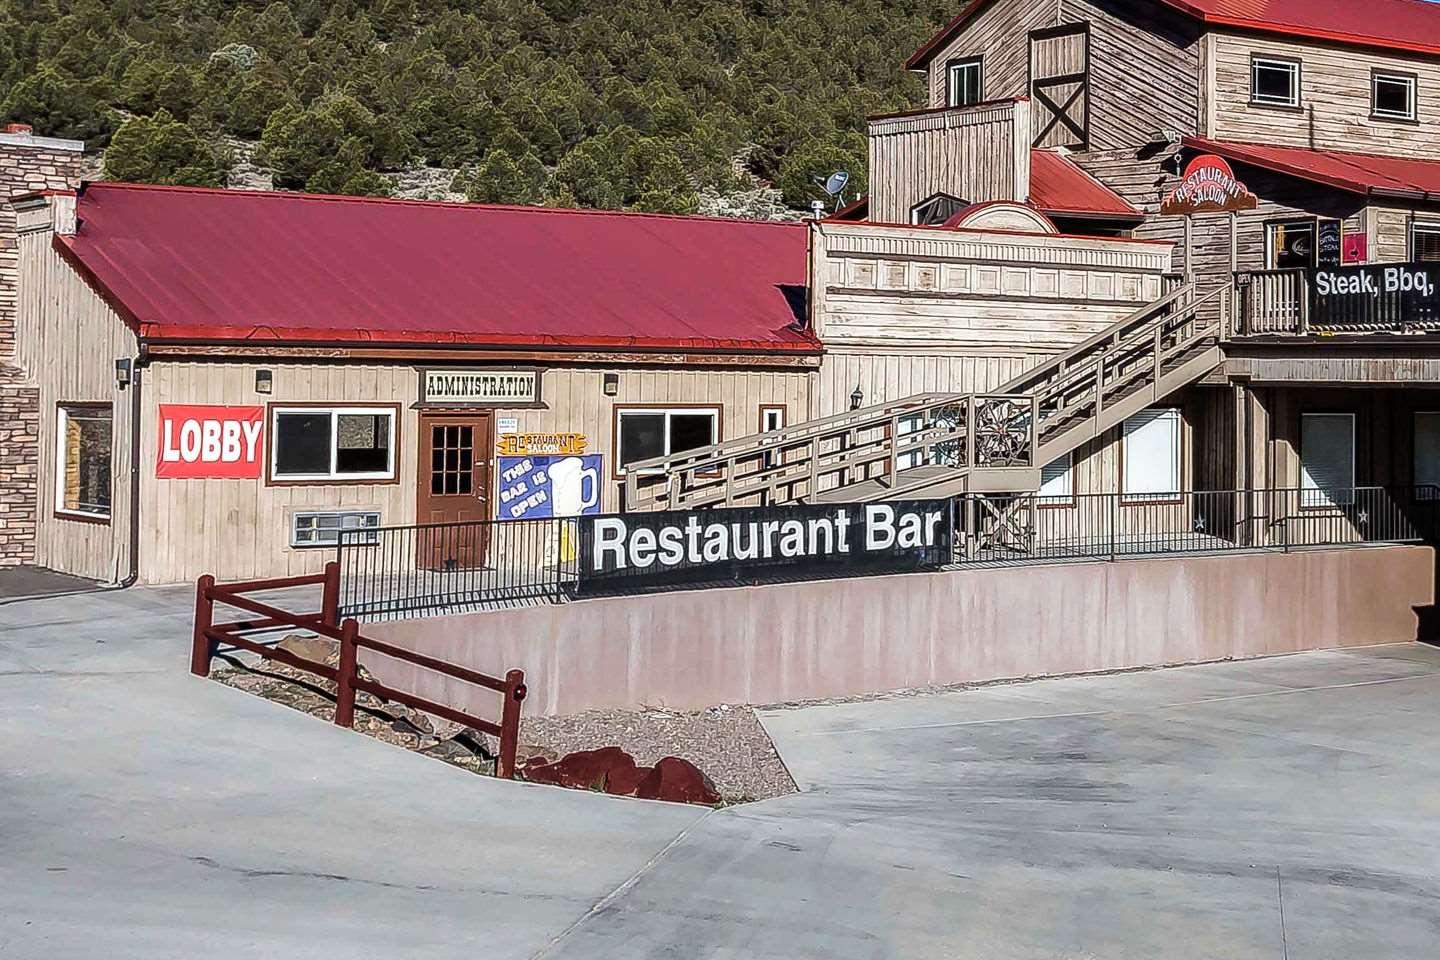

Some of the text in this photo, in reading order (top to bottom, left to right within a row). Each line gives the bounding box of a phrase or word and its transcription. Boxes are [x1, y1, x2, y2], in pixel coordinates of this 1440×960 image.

[1175, 166, 1241, 203] RESTAURANT
[1191, 184, 1227, 207] SALOON
[1315, 270, 1379, 297] Steak,
[1384, 267, 1434, 296] Bbq,
[427, 375, 534, 396] ADMINISTRATION
[162, 419, 263, 463] LOBBY
[508, 435, 575, 453] RESTAURANT
[527, 443, 561, 453] SALOON
[502, 459, 533, 483] THIS
[500, 470, 547, 504] BAR IS
[510, 489, 548, 518] OPEN
[593, 504, 942, 571] Restaurant Bar
